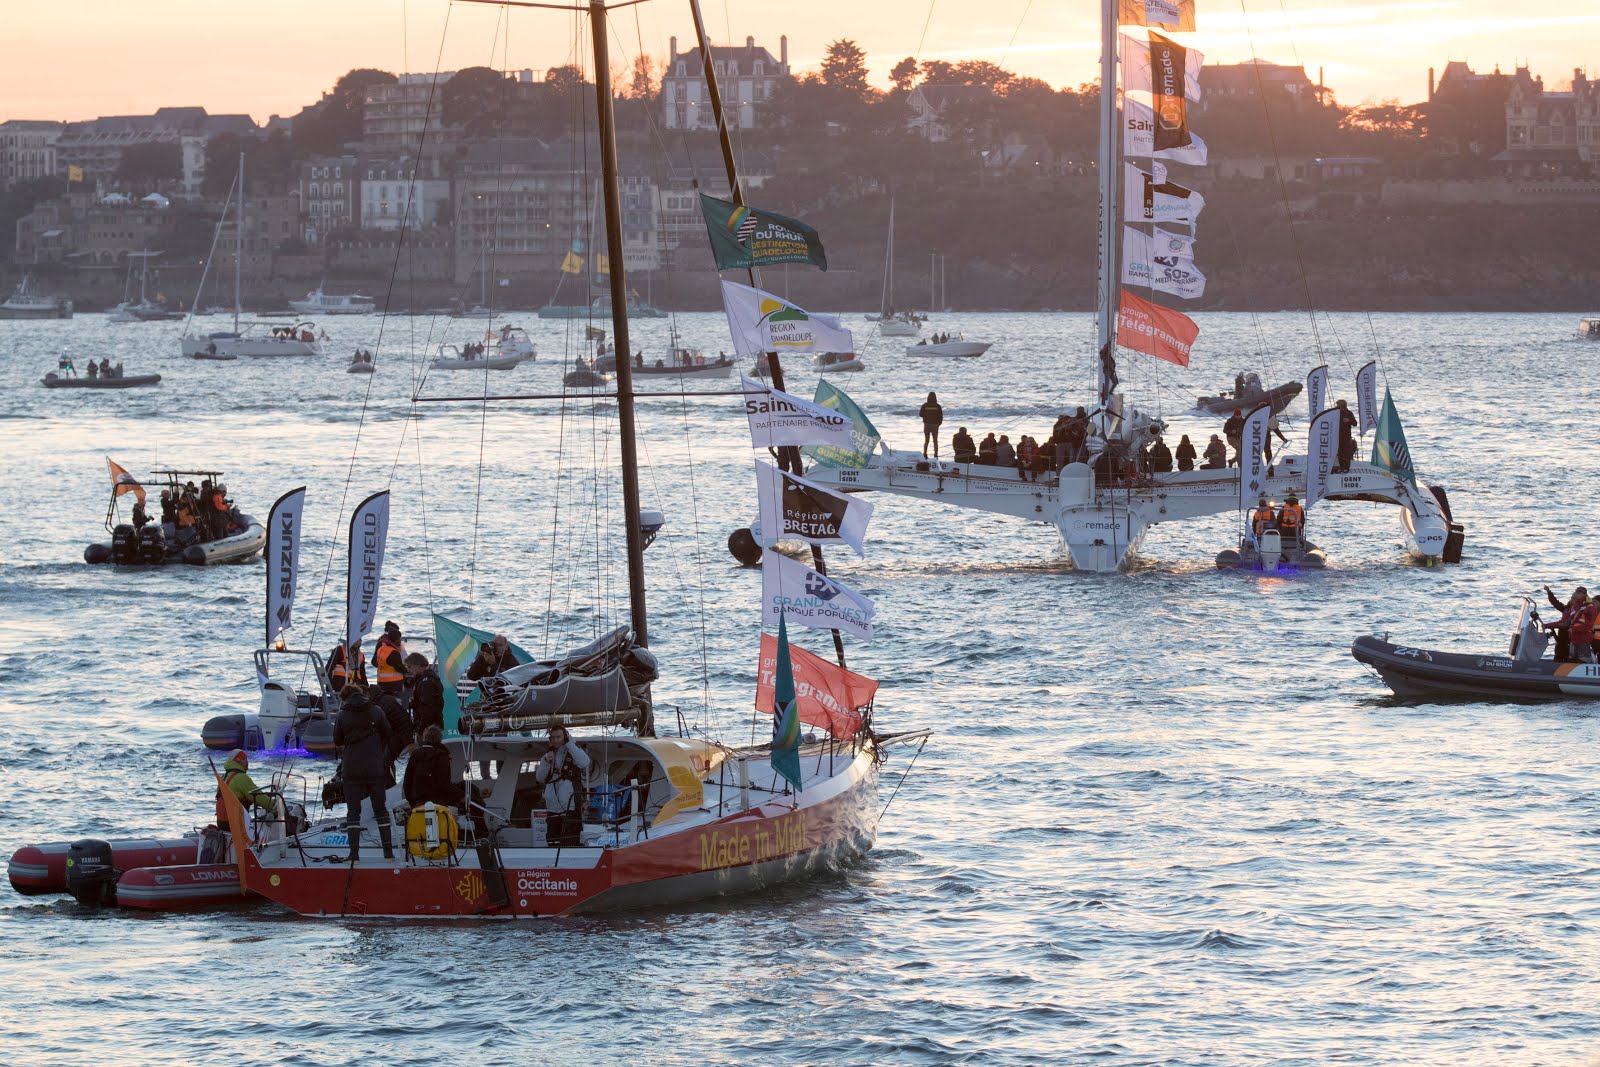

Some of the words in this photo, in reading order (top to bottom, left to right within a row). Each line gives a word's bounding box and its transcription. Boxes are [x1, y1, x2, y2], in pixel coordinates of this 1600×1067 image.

[756, 231, 773, 239] DU
[752, 241, 808, 250] DESTINATION
[753, 249, 808, 258] GUADELOUPE
[1122, 306, 1149, 320] groupe
[770, 323, 796, 333] REGION
[1120, 315, 1189, 353] Télégramme
[1311, 376, 1320, 415] SUZUKI
[1364, 373, 1372, 420] HIGHFIELD
[756, 420, 808, 429] PARTENAIRE
[850, 430, 875, 447] OUTE
[1252, 421, 1261, 476] SUZUKI
[1318, 421, 1330, 486] HIGHFIELD
[787, 510, 826, 521] Région
[1085, 522, 1121, 530] remade
[281, 512, 293, 599] SUZUKI
[362, 513, 376, 613] HIGHFIELD
[773, 595, 824, 608] GRAND
[773, 606, 814, 616] BANQUE
[817, 609, 869, 630] POPULAIRE
[1394, 646, 1419, 657] 24
[701, 826, 750, 871] Made
[755, 823, 771, 861] in
[774, 813, 806, 856] Midi
[190, 870, 238, 881] LOMAC
[518, 878, 577, 890] Occitanie
